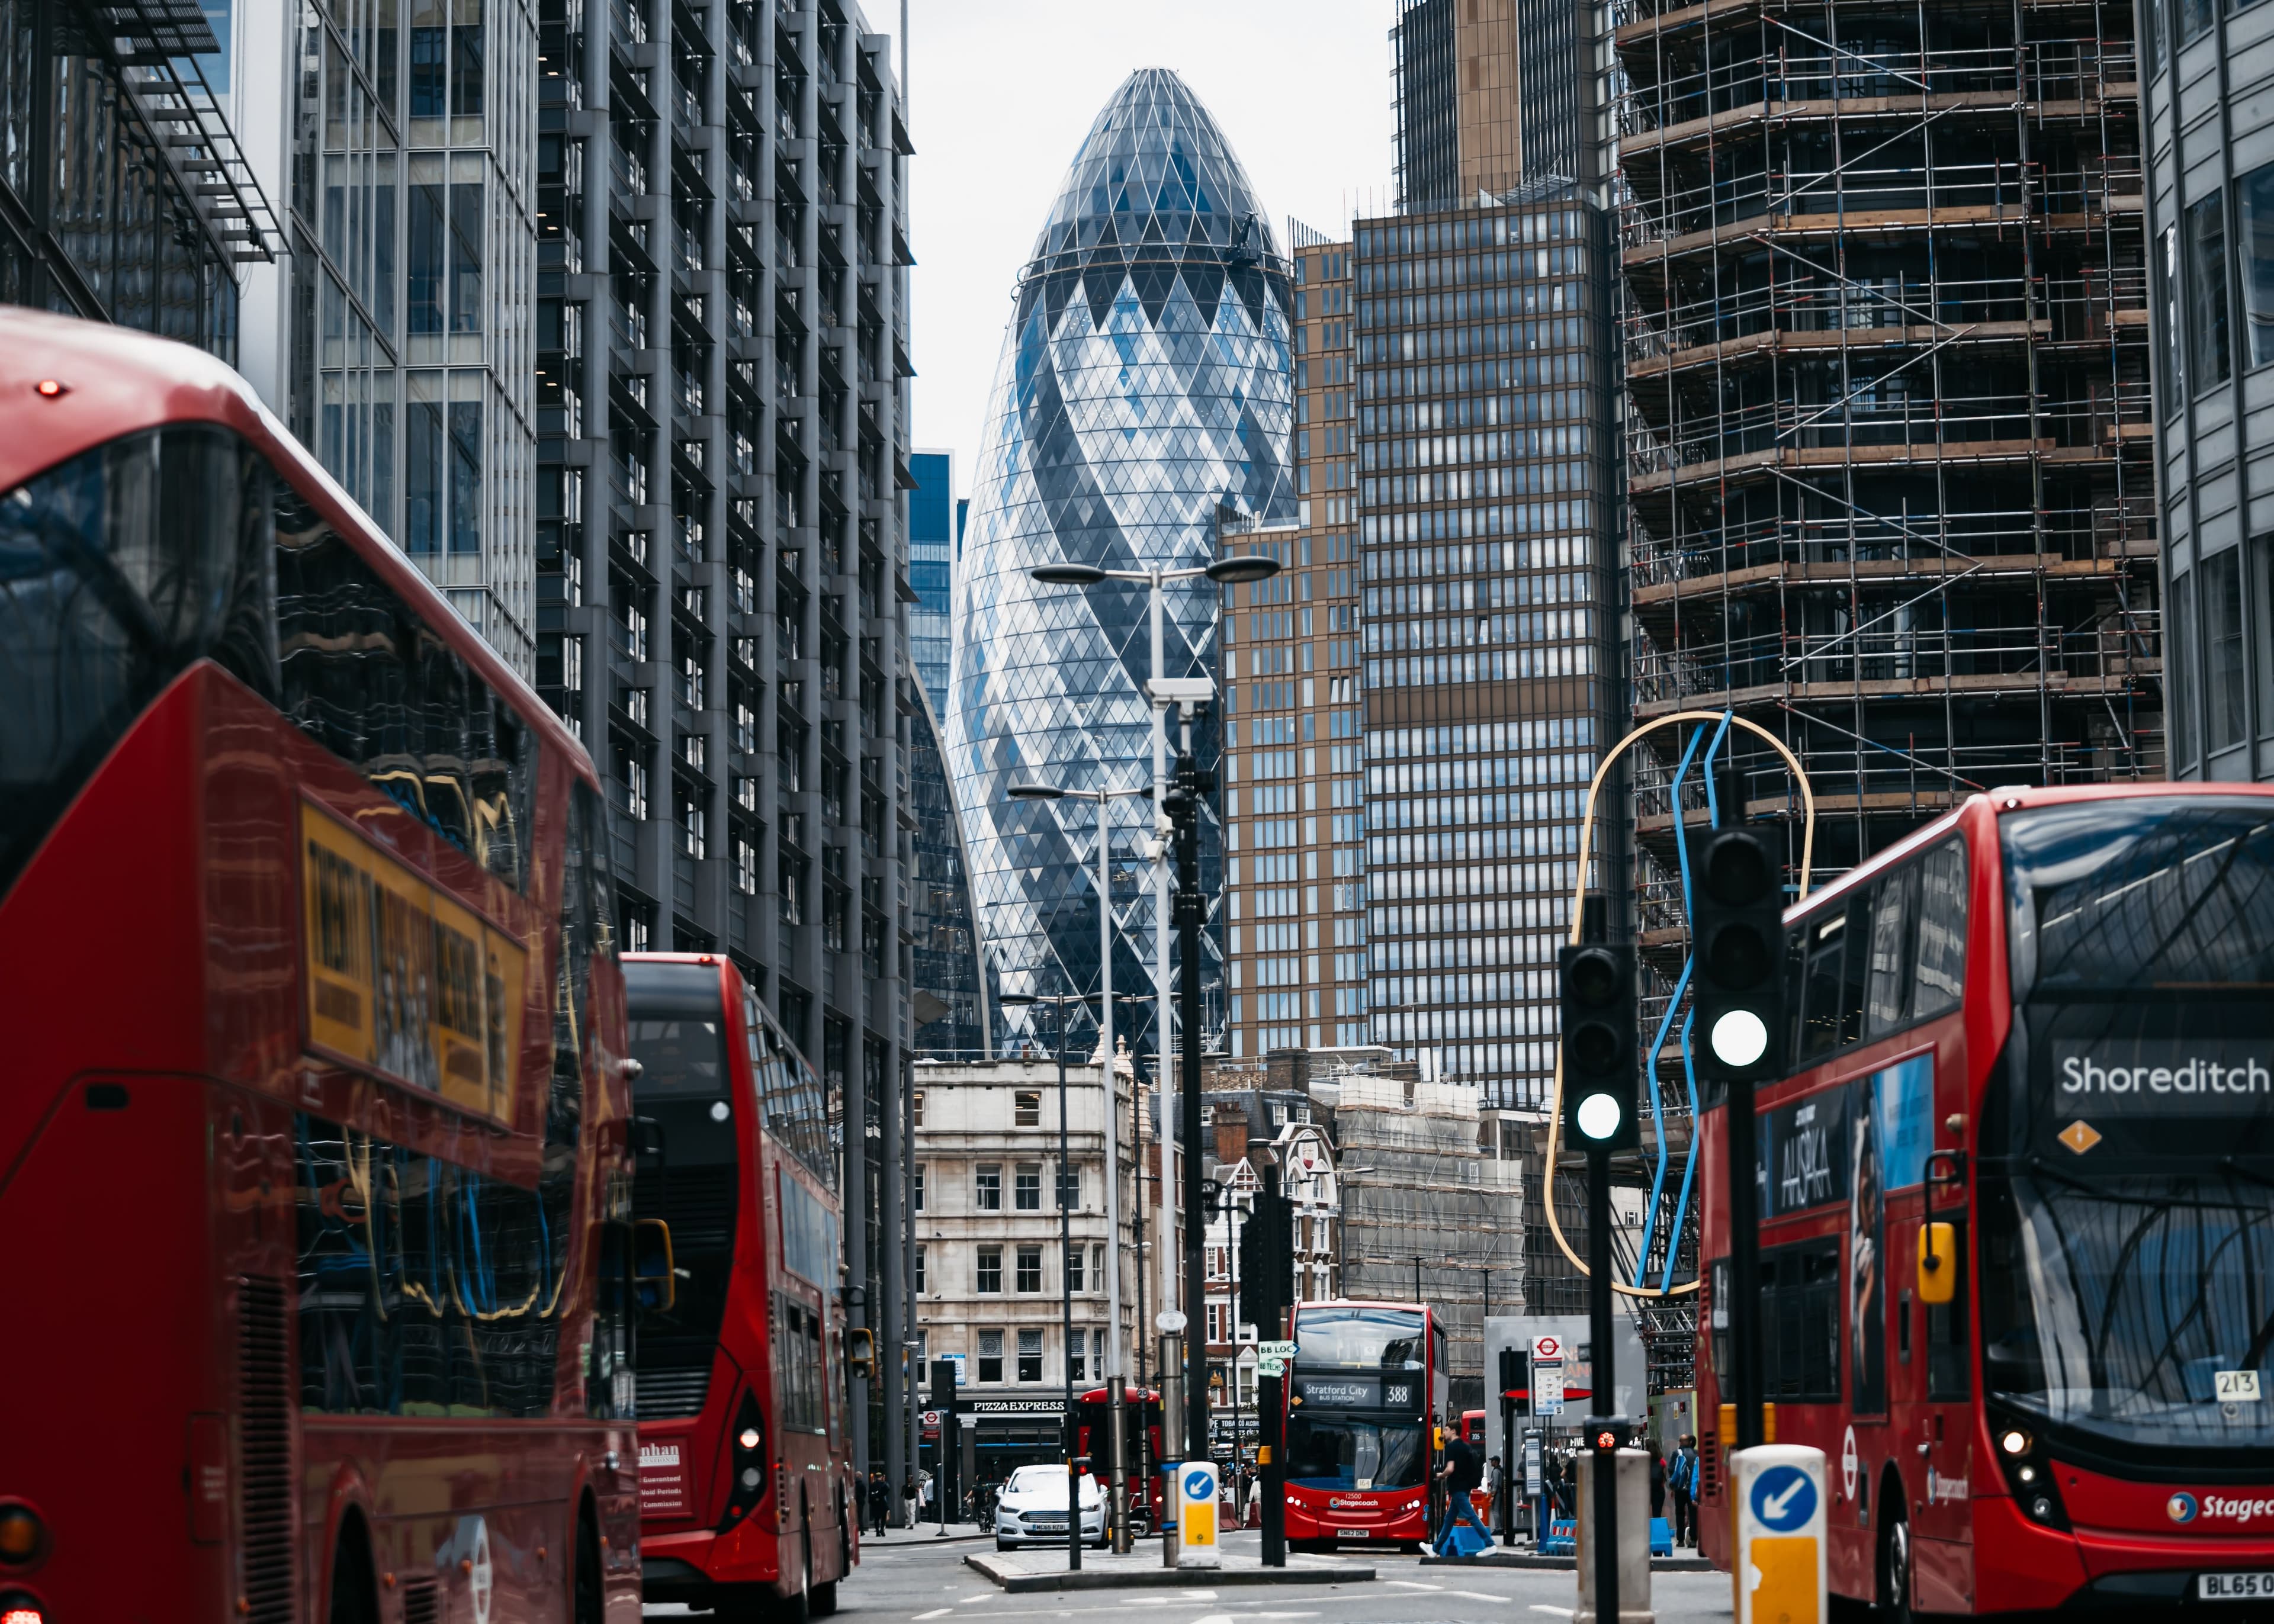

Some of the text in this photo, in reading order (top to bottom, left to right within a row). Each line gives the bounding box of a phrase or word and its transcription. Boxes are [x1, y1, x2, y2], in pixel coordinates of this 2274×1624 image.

[2062, 1057, 2270, 1092] Shoreditch
[1306, 1384, 1367, 1398] Stratford City
[2220, 1374, 2255, 1393] 213
[1387, 1386, 1408, 1403] 388
[641, 1443, 679, 1456] nhan
[2202, 1496, 2274, 1523] Stagec
[2207, 1574, 2257, 1595] BL65
